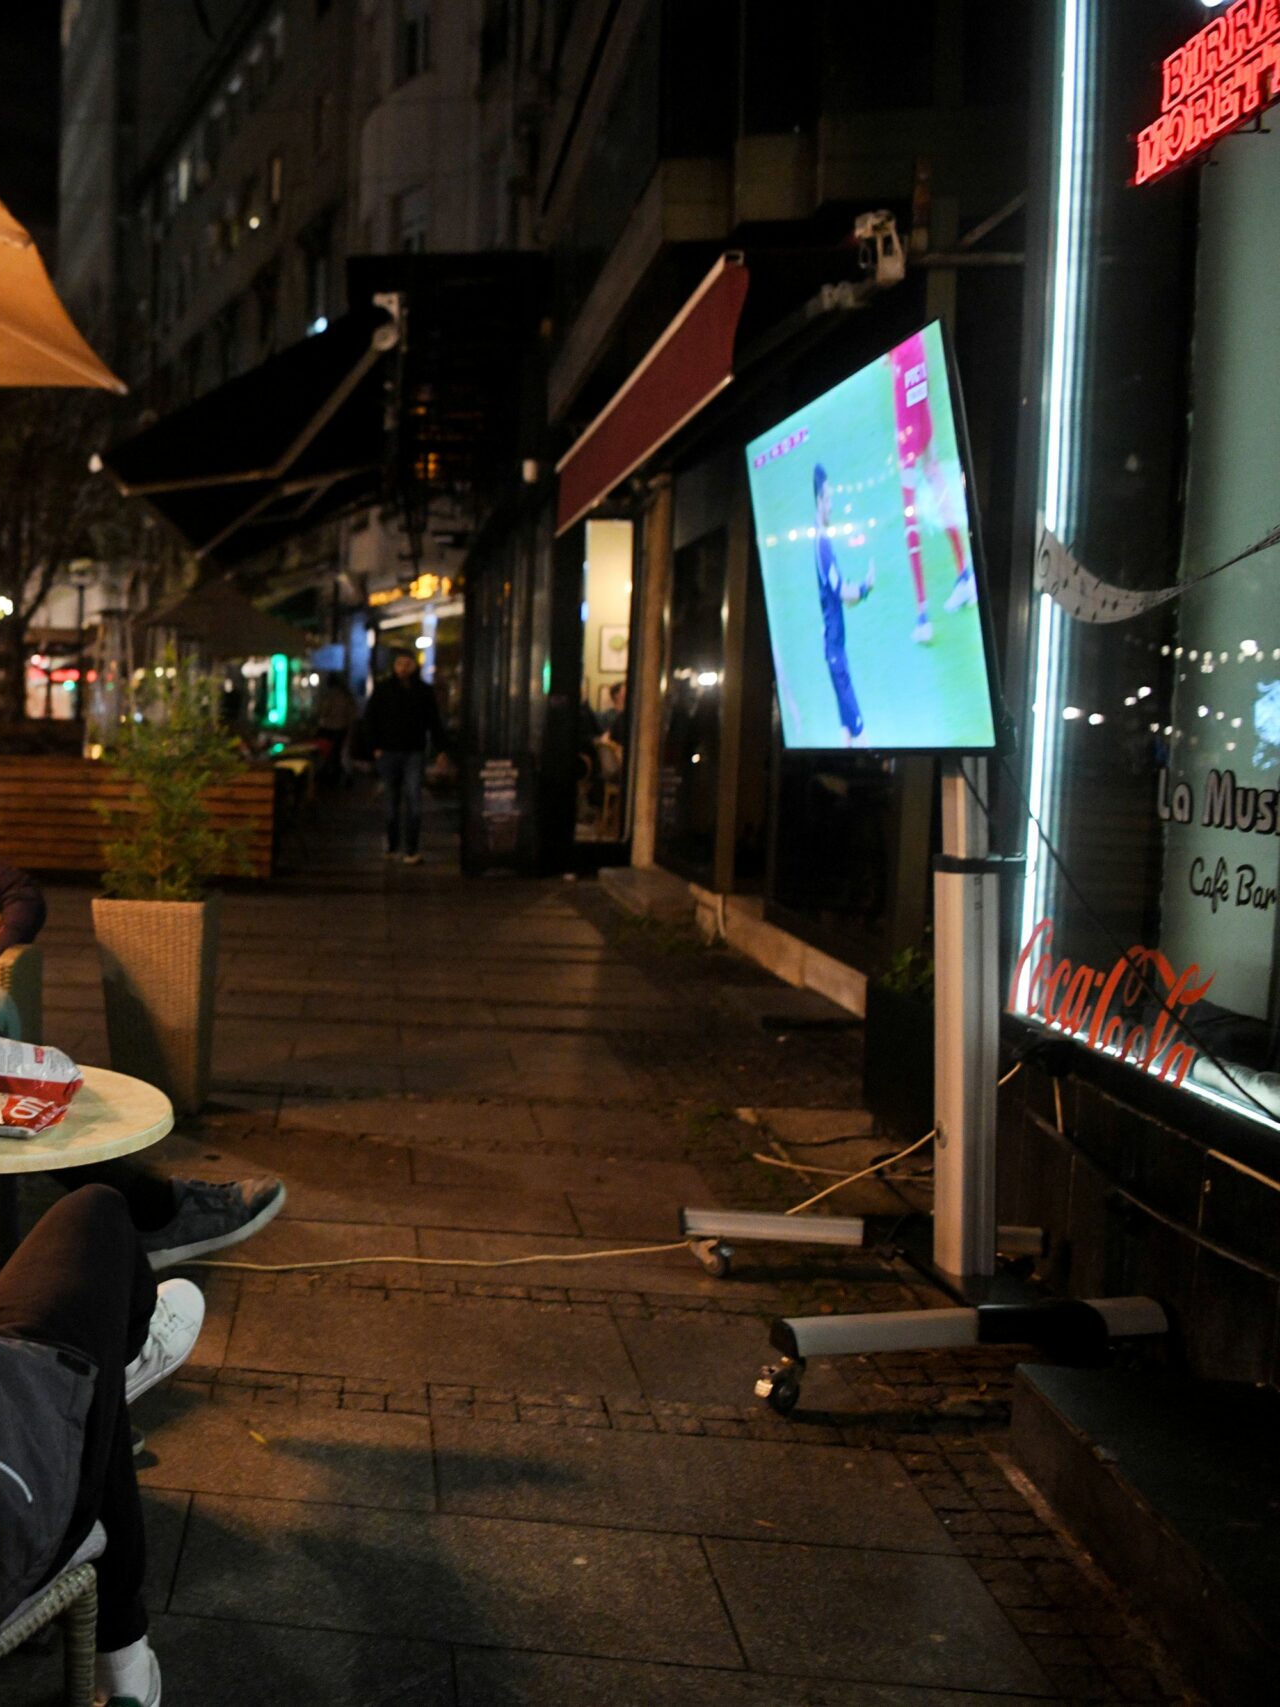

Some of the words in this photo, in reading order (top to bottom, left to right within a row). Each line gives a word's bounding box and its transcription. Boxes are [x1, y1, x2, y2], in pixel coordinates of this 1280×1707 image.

[1157, 767, 1193, 824] La
[1235, 863, 1277, 911] Bar
[1007, 918, 1217, 1088] Coca-Cola
